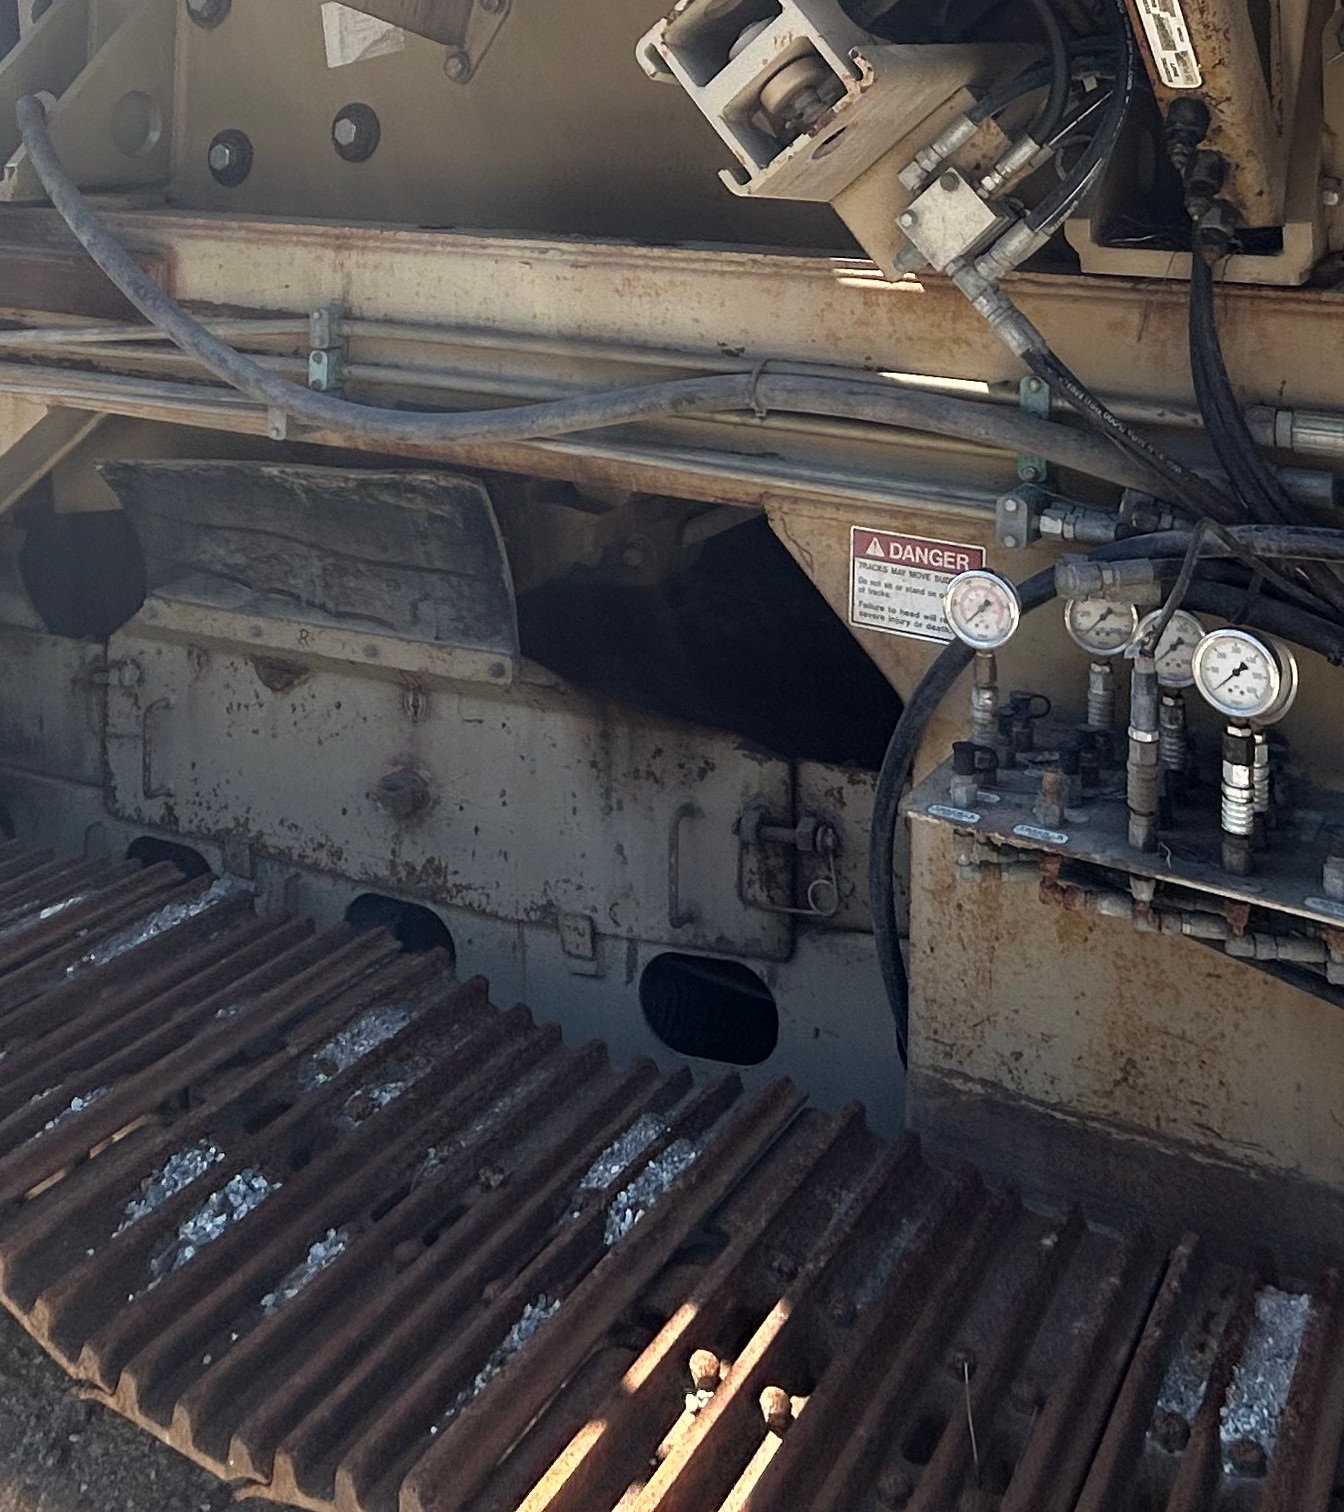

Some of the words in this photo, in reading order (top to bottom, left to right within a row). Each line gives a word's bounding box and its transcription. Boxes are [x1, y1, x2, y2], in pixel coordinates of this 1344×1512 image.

[888, 542, 970, 571] DANGER
[858, 560, 889, 574] TRACKS
[890, 566, 906, 577] MAY
[909, 569, 931, 582] MOVE
[857, 576, 868, 585] Do
[905, 585, 926, 596] stand
[858, 600, 885, 612] Failure
[887, 606, 897, 614] to
[899, 608, 921, 620] heed
[923, 613, 937, 623] will
[858, 610, 886, 622] severe
[888, 615, 911, 628] injury
